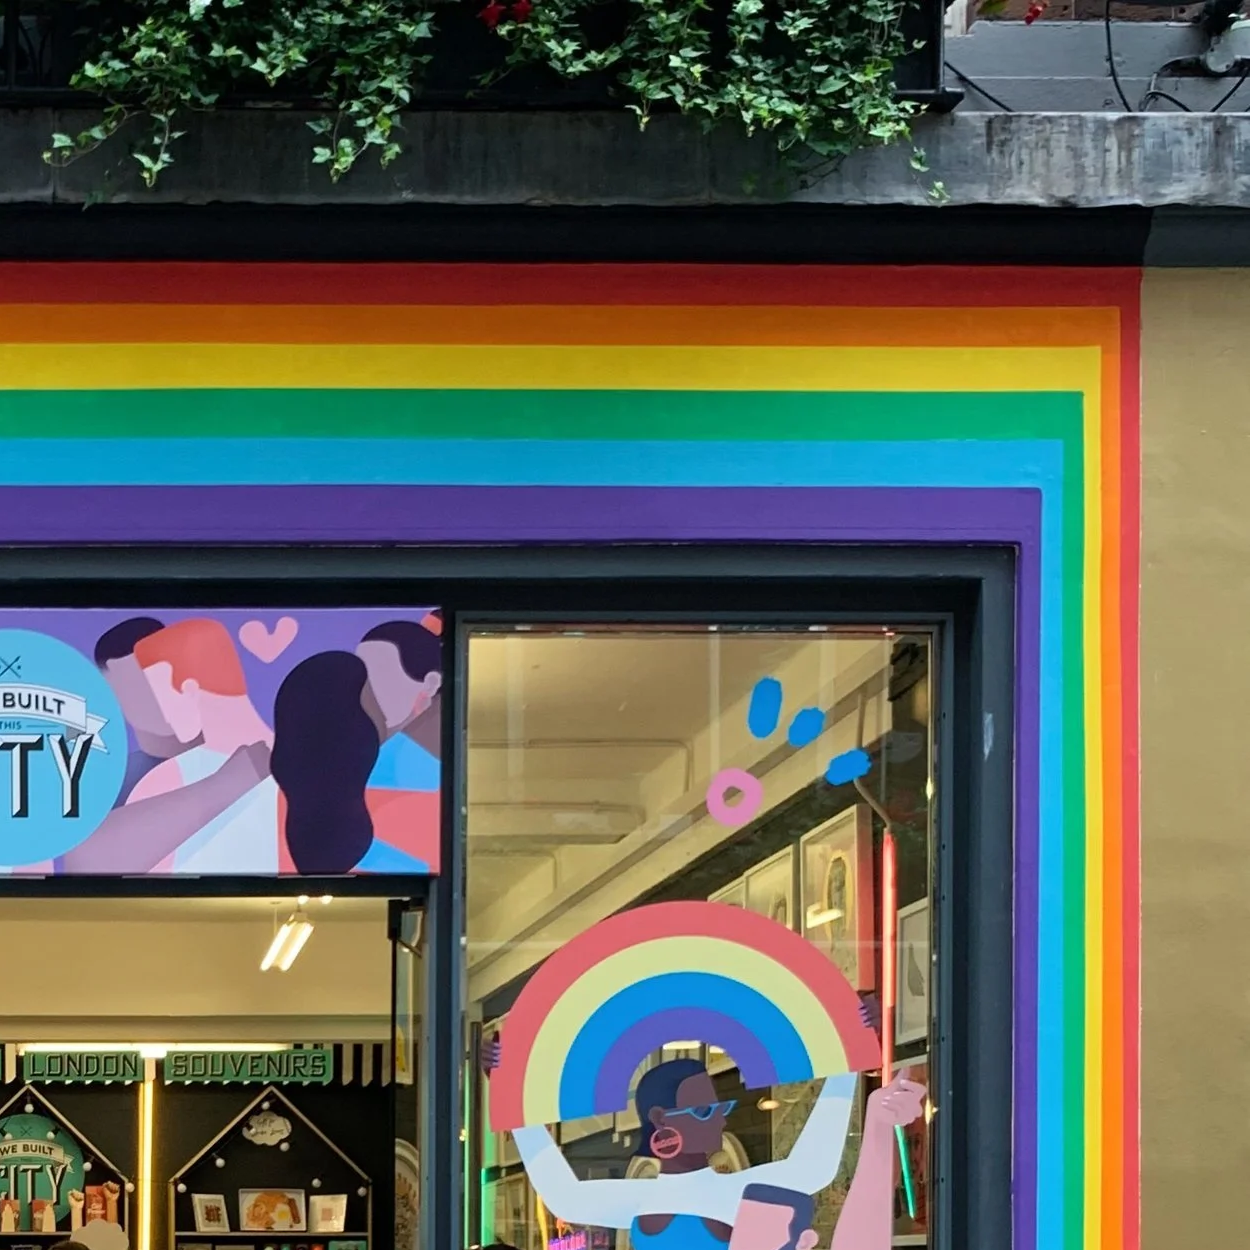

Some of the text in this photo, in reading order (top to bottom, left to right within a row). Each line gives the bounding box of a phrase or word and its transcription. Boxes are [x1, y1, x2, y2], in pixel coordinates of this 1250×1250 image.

[2, 692, 66, 715] BUILT
[29, 1053, 139, 1077] LONDON
[170, 1053, 326, 1077] SOUVENIRS
[0, 1144, 55, 1156] WE BUILT
